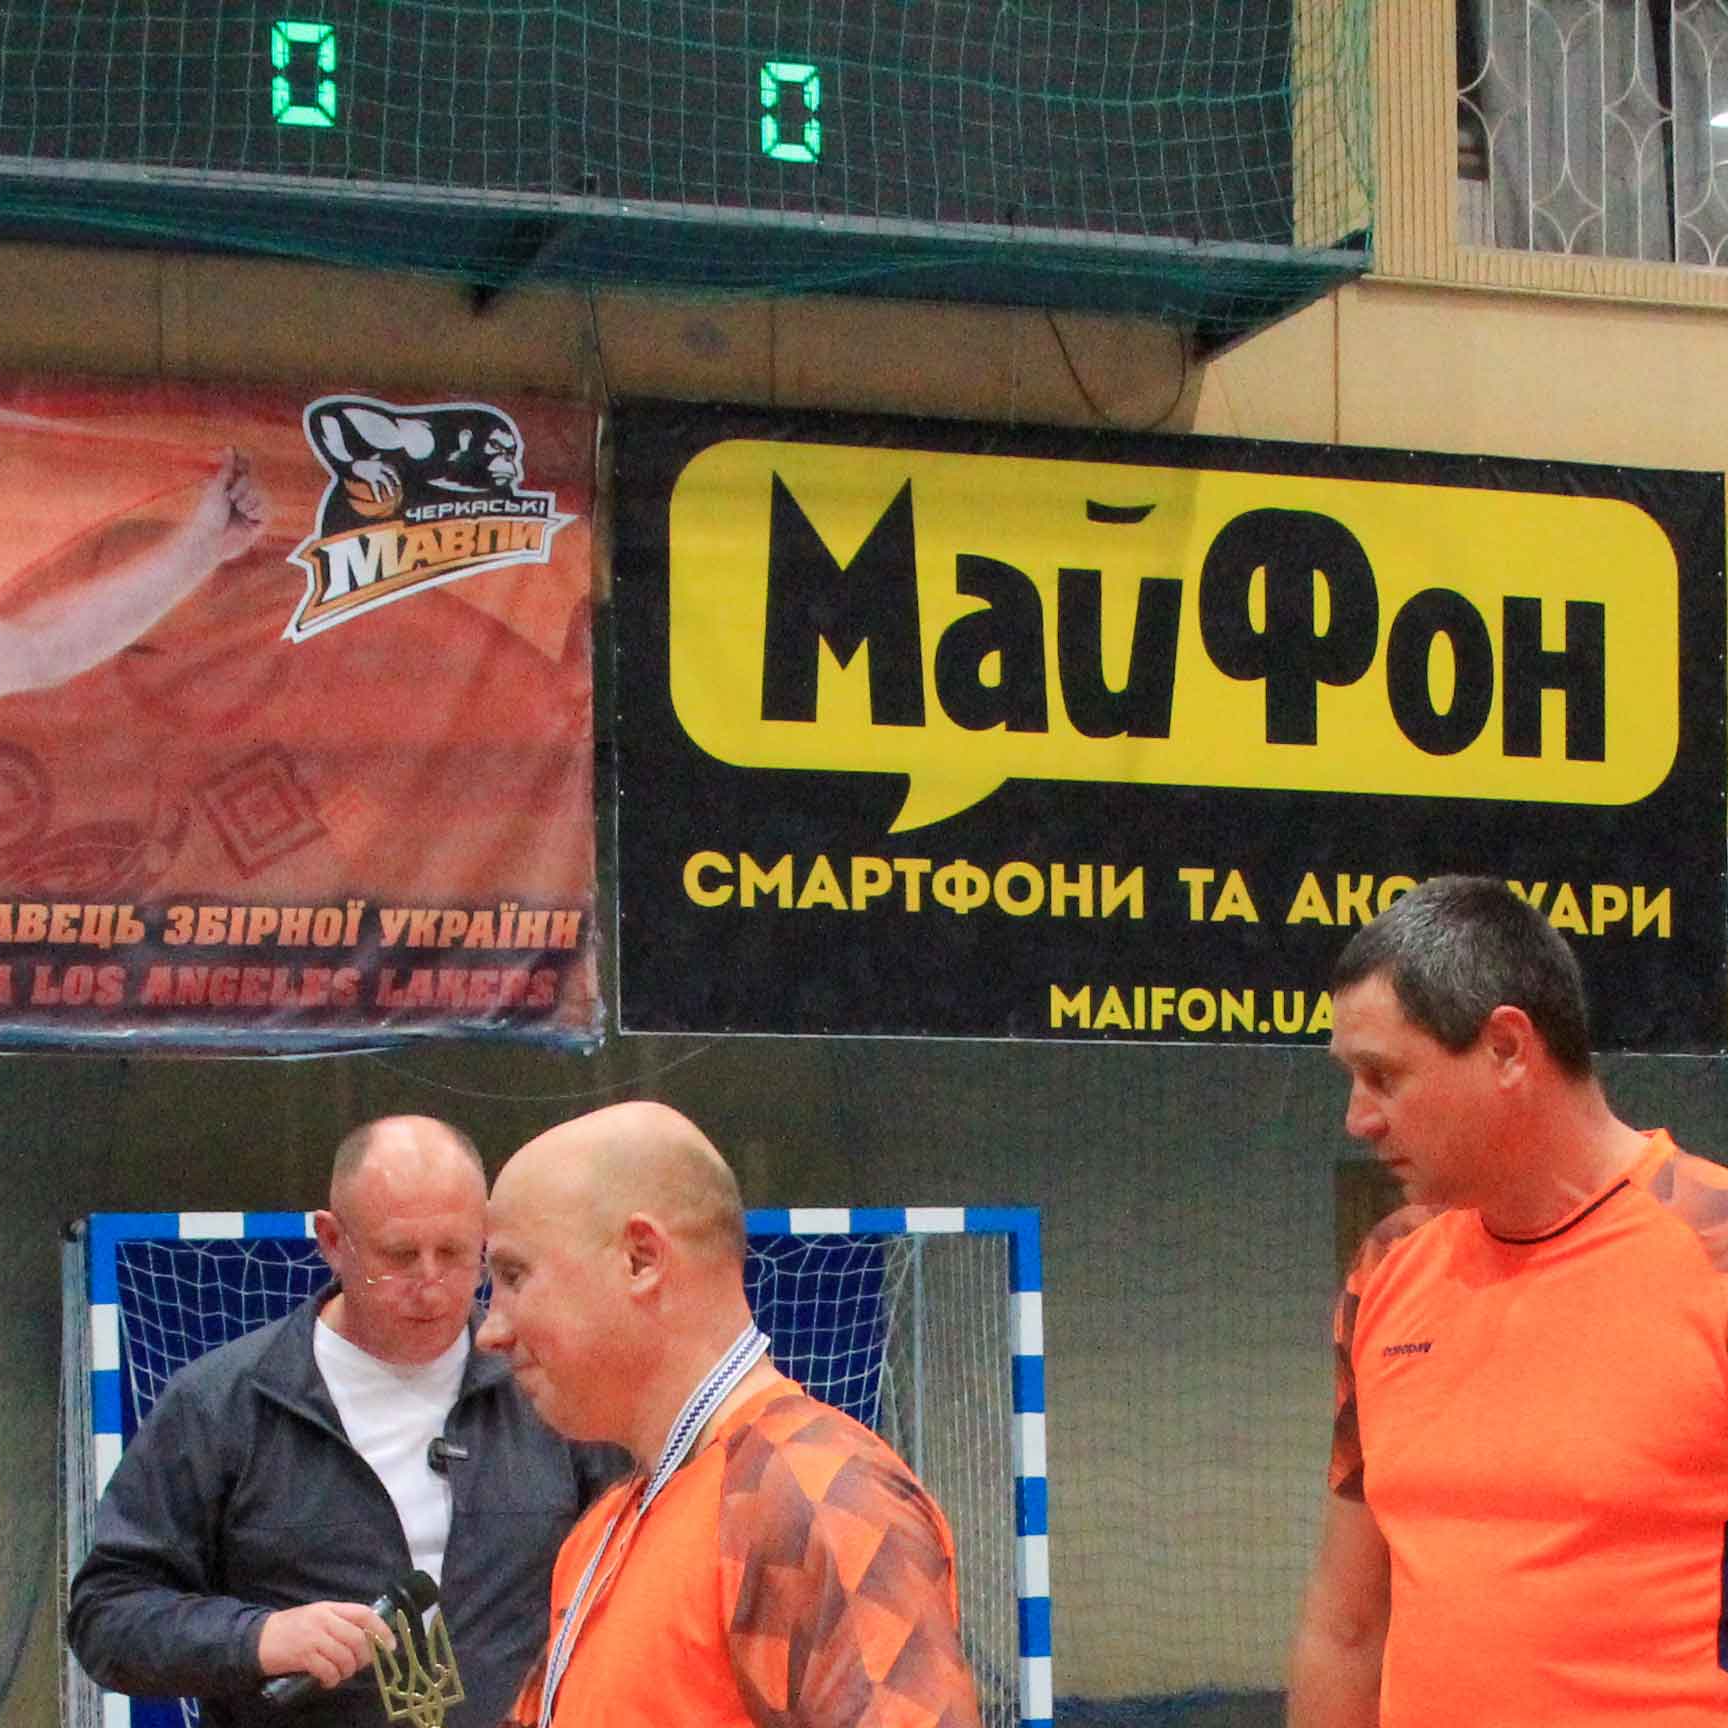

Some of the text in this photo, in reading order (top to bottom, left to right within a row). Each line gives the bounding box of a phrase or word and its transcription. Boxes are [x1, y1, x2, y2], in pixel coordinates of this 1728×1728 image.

[272, 21, 336, 127] 0
[761, 62, 820, 163] 0
[405, 499, 546, 520] ЧЕРКАСЬКІ
[759, 469, 1608, 762] МайФон
[683, 850, 1145, 920] СМАРТФОНИ
[1179, 868, 1259, 922] ТА
[163, 900, 367, 948] ЗБІРНОЇ
[377, 903, 582, 949] УКРАЇНИ
[30, 964, 126, 1006] LOS
[141, 966, 361, 1009] ANGELES
